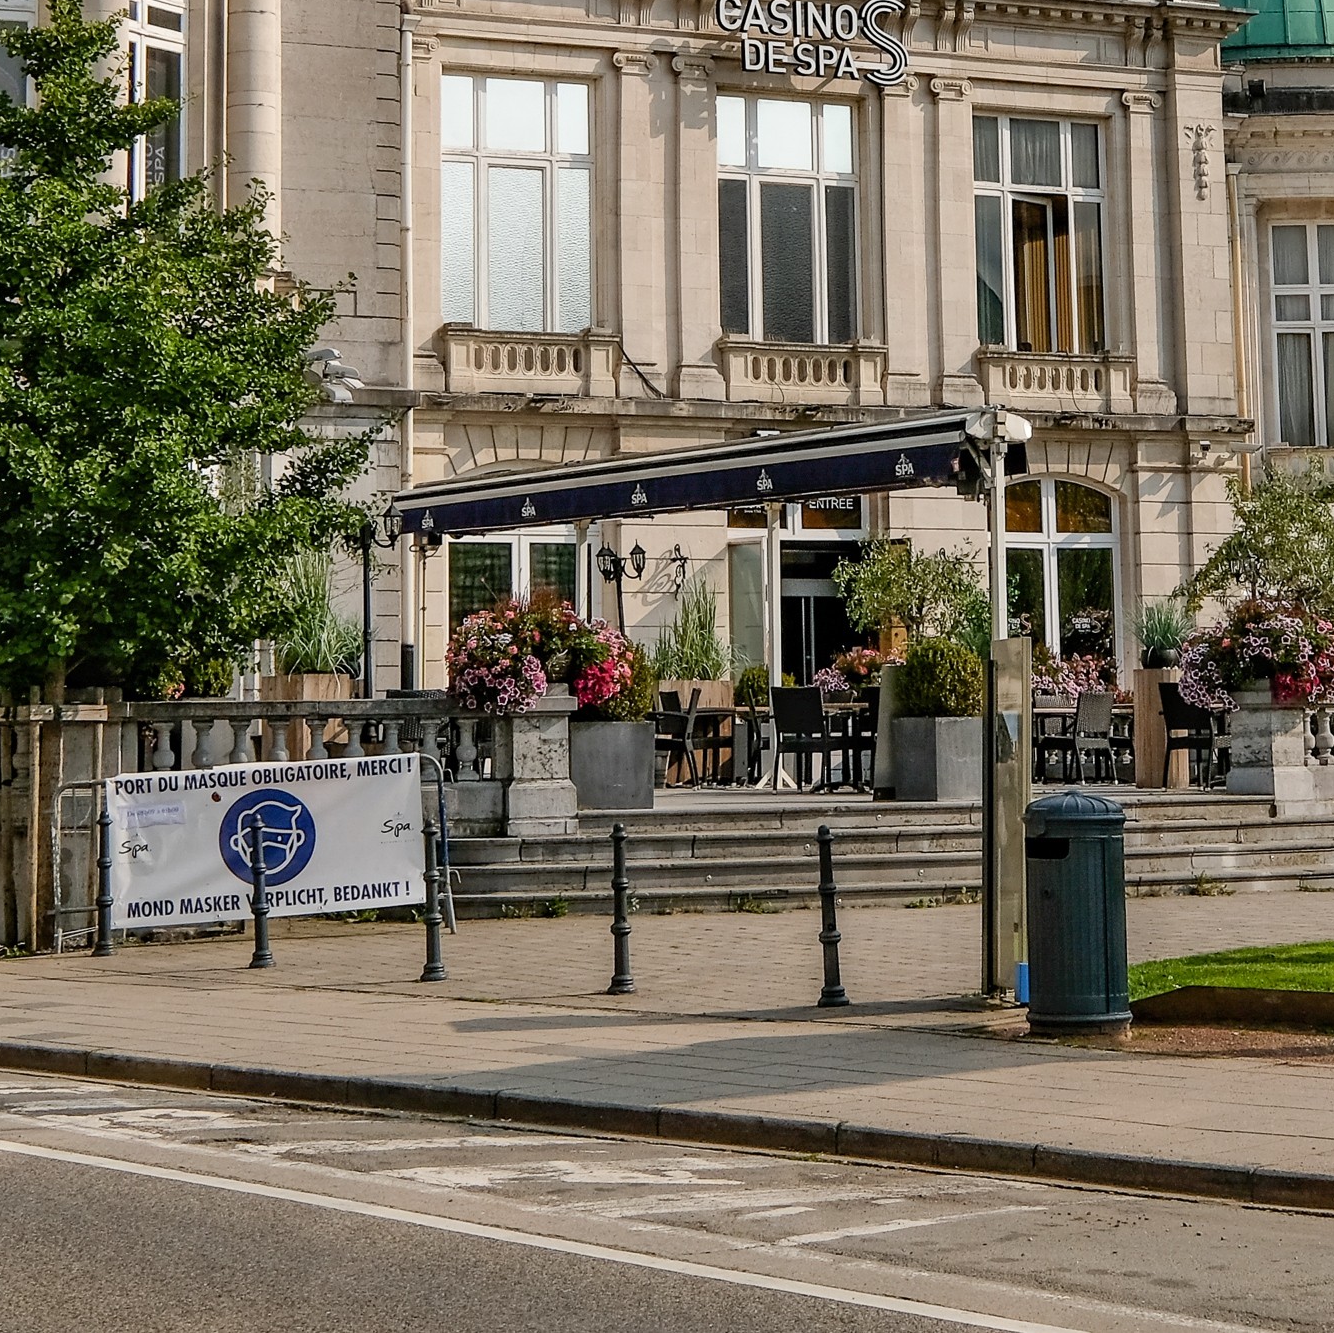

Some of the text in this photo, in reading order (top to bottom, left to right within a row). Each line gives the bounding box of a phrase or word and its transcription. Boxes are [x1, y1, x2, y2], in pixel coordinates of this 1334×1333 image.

[743, 39, 859, 80] DE SPA
[895, 463, 914, 476] SPA
[756, 478, 773, 491] SPA
[631, 493, 648, 504] SPA
[521, 506, 536, 517] SPA
[115, 778, 152, 796] PORT
[158, 776, 179, 792] DU
[184, 770, 247, 790] MASQUE
[251, 763, 351, 785] OBLIGATOIRE,
[357, 758, 402, 777] MERCI
[127, 900, 174, 918] MOND
[179, 894, 240, 915] MASKER
[334, 881, 400, 903] BEDANKT
